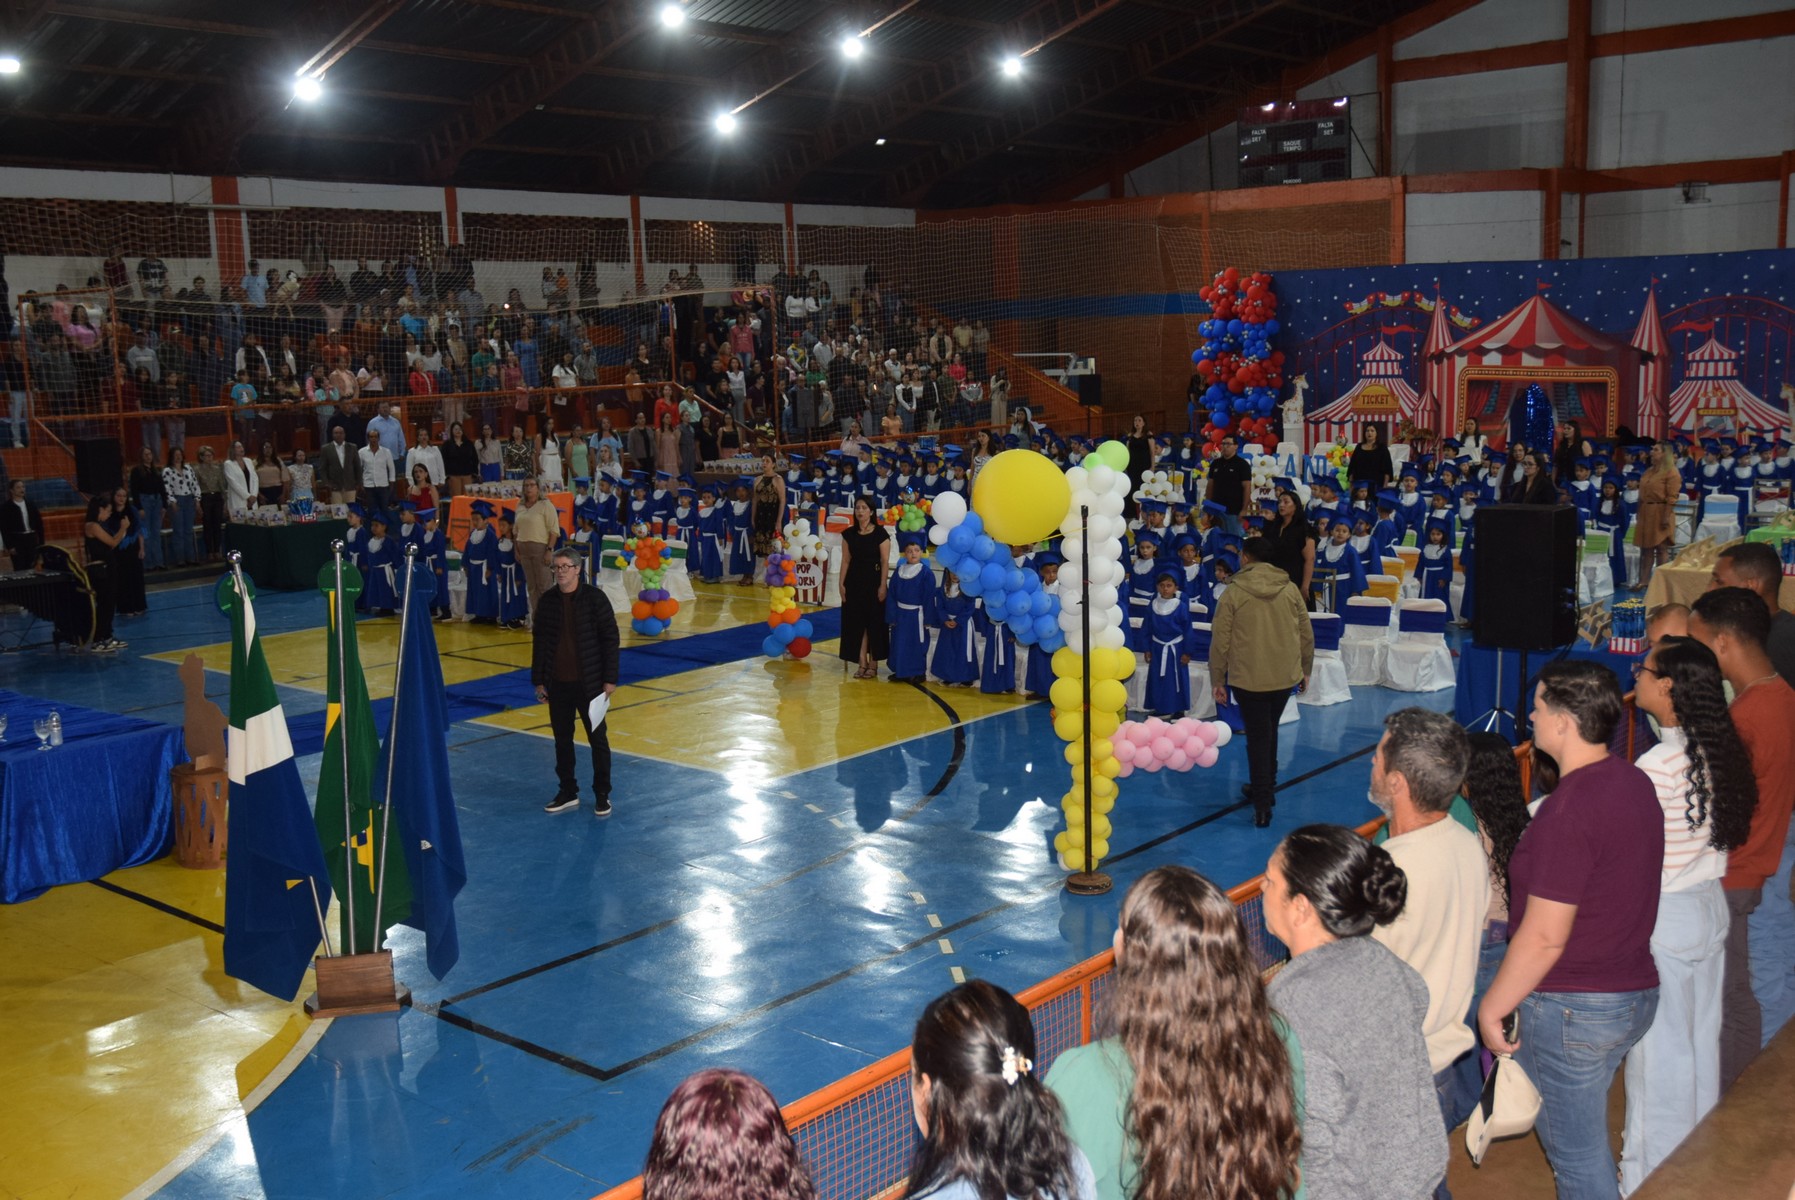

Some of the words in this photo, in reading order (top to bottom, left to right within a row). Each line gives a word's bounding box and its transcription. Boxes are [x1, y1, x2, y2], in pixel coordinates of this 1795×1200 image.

[1361, 394, 1389, 405] TICKET
[1259, 487, 1271, 495] POP
[796, 563, 812, 574] POP
[798, 576, 816, 586] ORN
